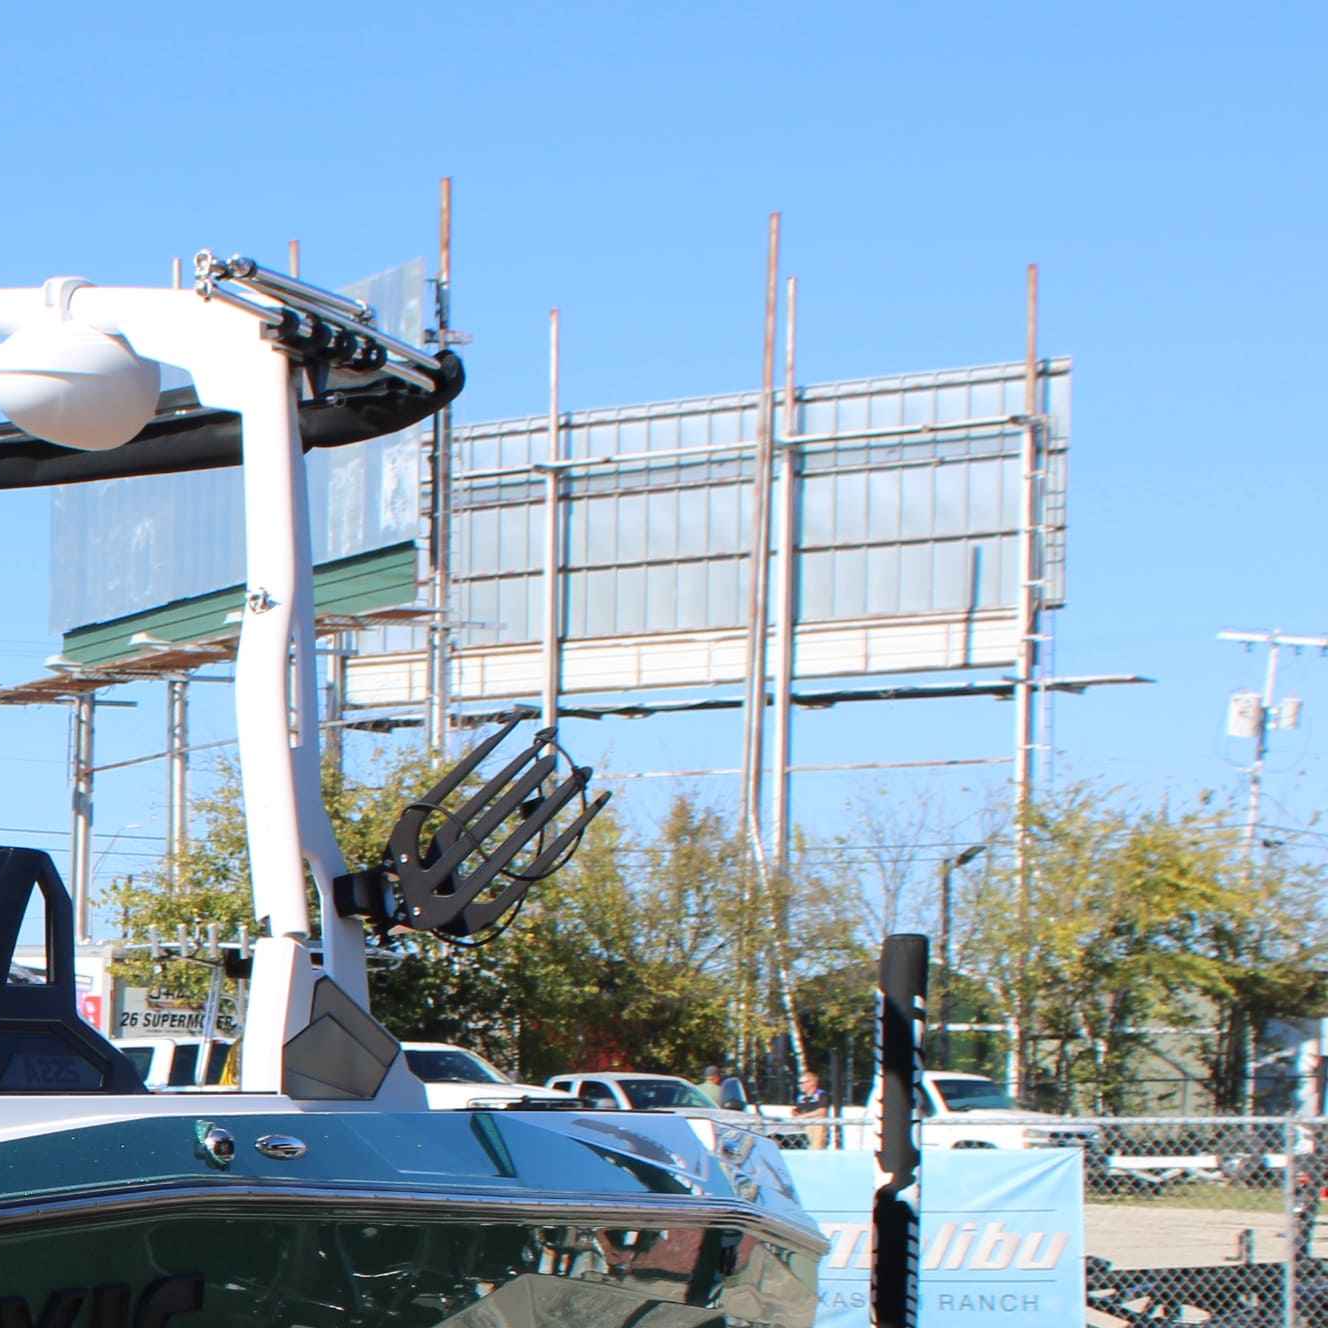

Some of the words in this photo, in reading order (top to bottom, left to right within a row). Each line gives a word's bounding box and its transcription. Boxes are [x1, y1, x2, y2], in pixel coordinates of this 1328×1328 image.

[121, 1012, 138, 1027] 26
[143, 1013, 234, 1030] SUPERMER
[823, 1221, 1070, 1271] Mlibu
[938, 1293, 1040, 1313] RANCH
